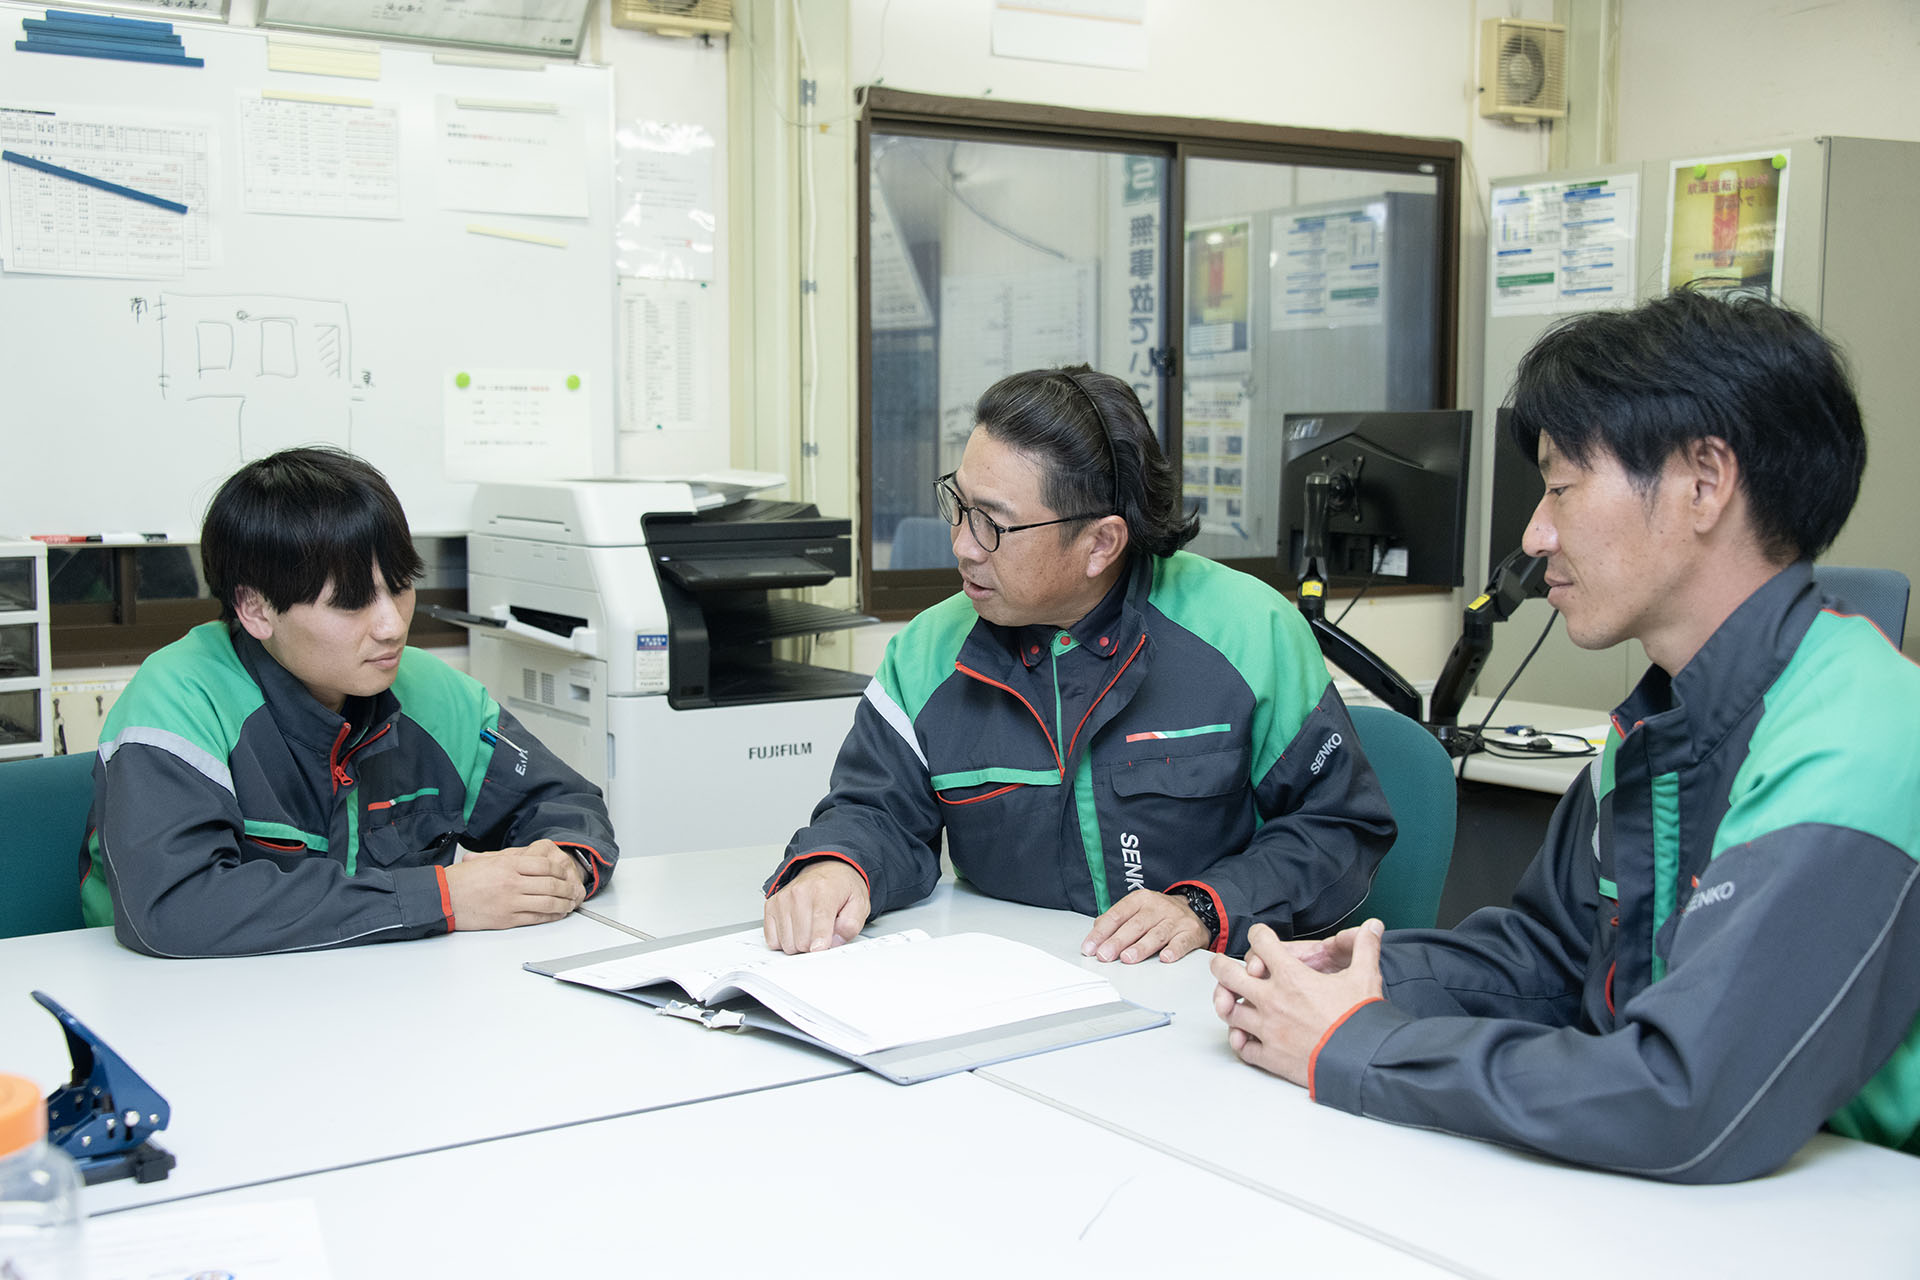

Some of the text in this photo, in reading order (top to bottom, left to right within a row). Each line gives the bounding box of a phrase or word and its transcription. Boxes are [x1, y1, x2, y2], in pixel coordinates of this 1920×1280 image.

[748, 741, 812, 760] FUJIFILM
[1310, 732, 1343, 776] SENKO
[1120, 832, 1145, 892] SENK
